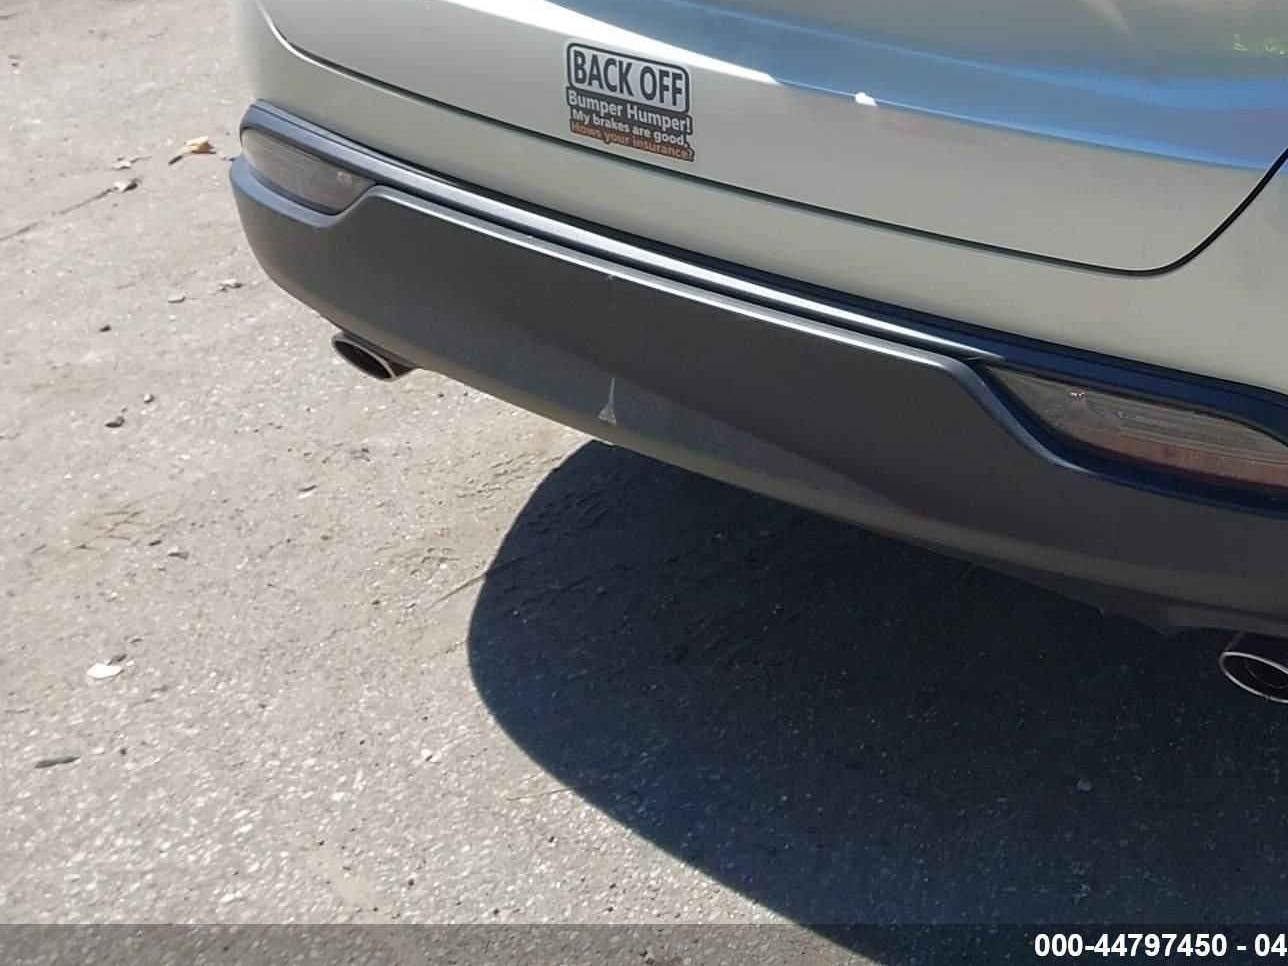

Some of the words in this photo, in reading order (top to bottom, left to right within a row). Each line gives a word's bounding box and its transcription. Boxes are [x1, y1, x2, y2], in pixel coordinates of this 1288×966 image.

[573, 49, 634, 97] BACK
[639, 65, 684, 107] OFF
[568, 89, 623, 117] Bumper
[626, 103, 691, 133] Humper!
[572, 108, 590, 125] My
[593, 115, 630, 133] brakes
[632, 126, 651, 138] are
[604, 130, 630, 145] your
[632, 135, 694, 160] insurance?
